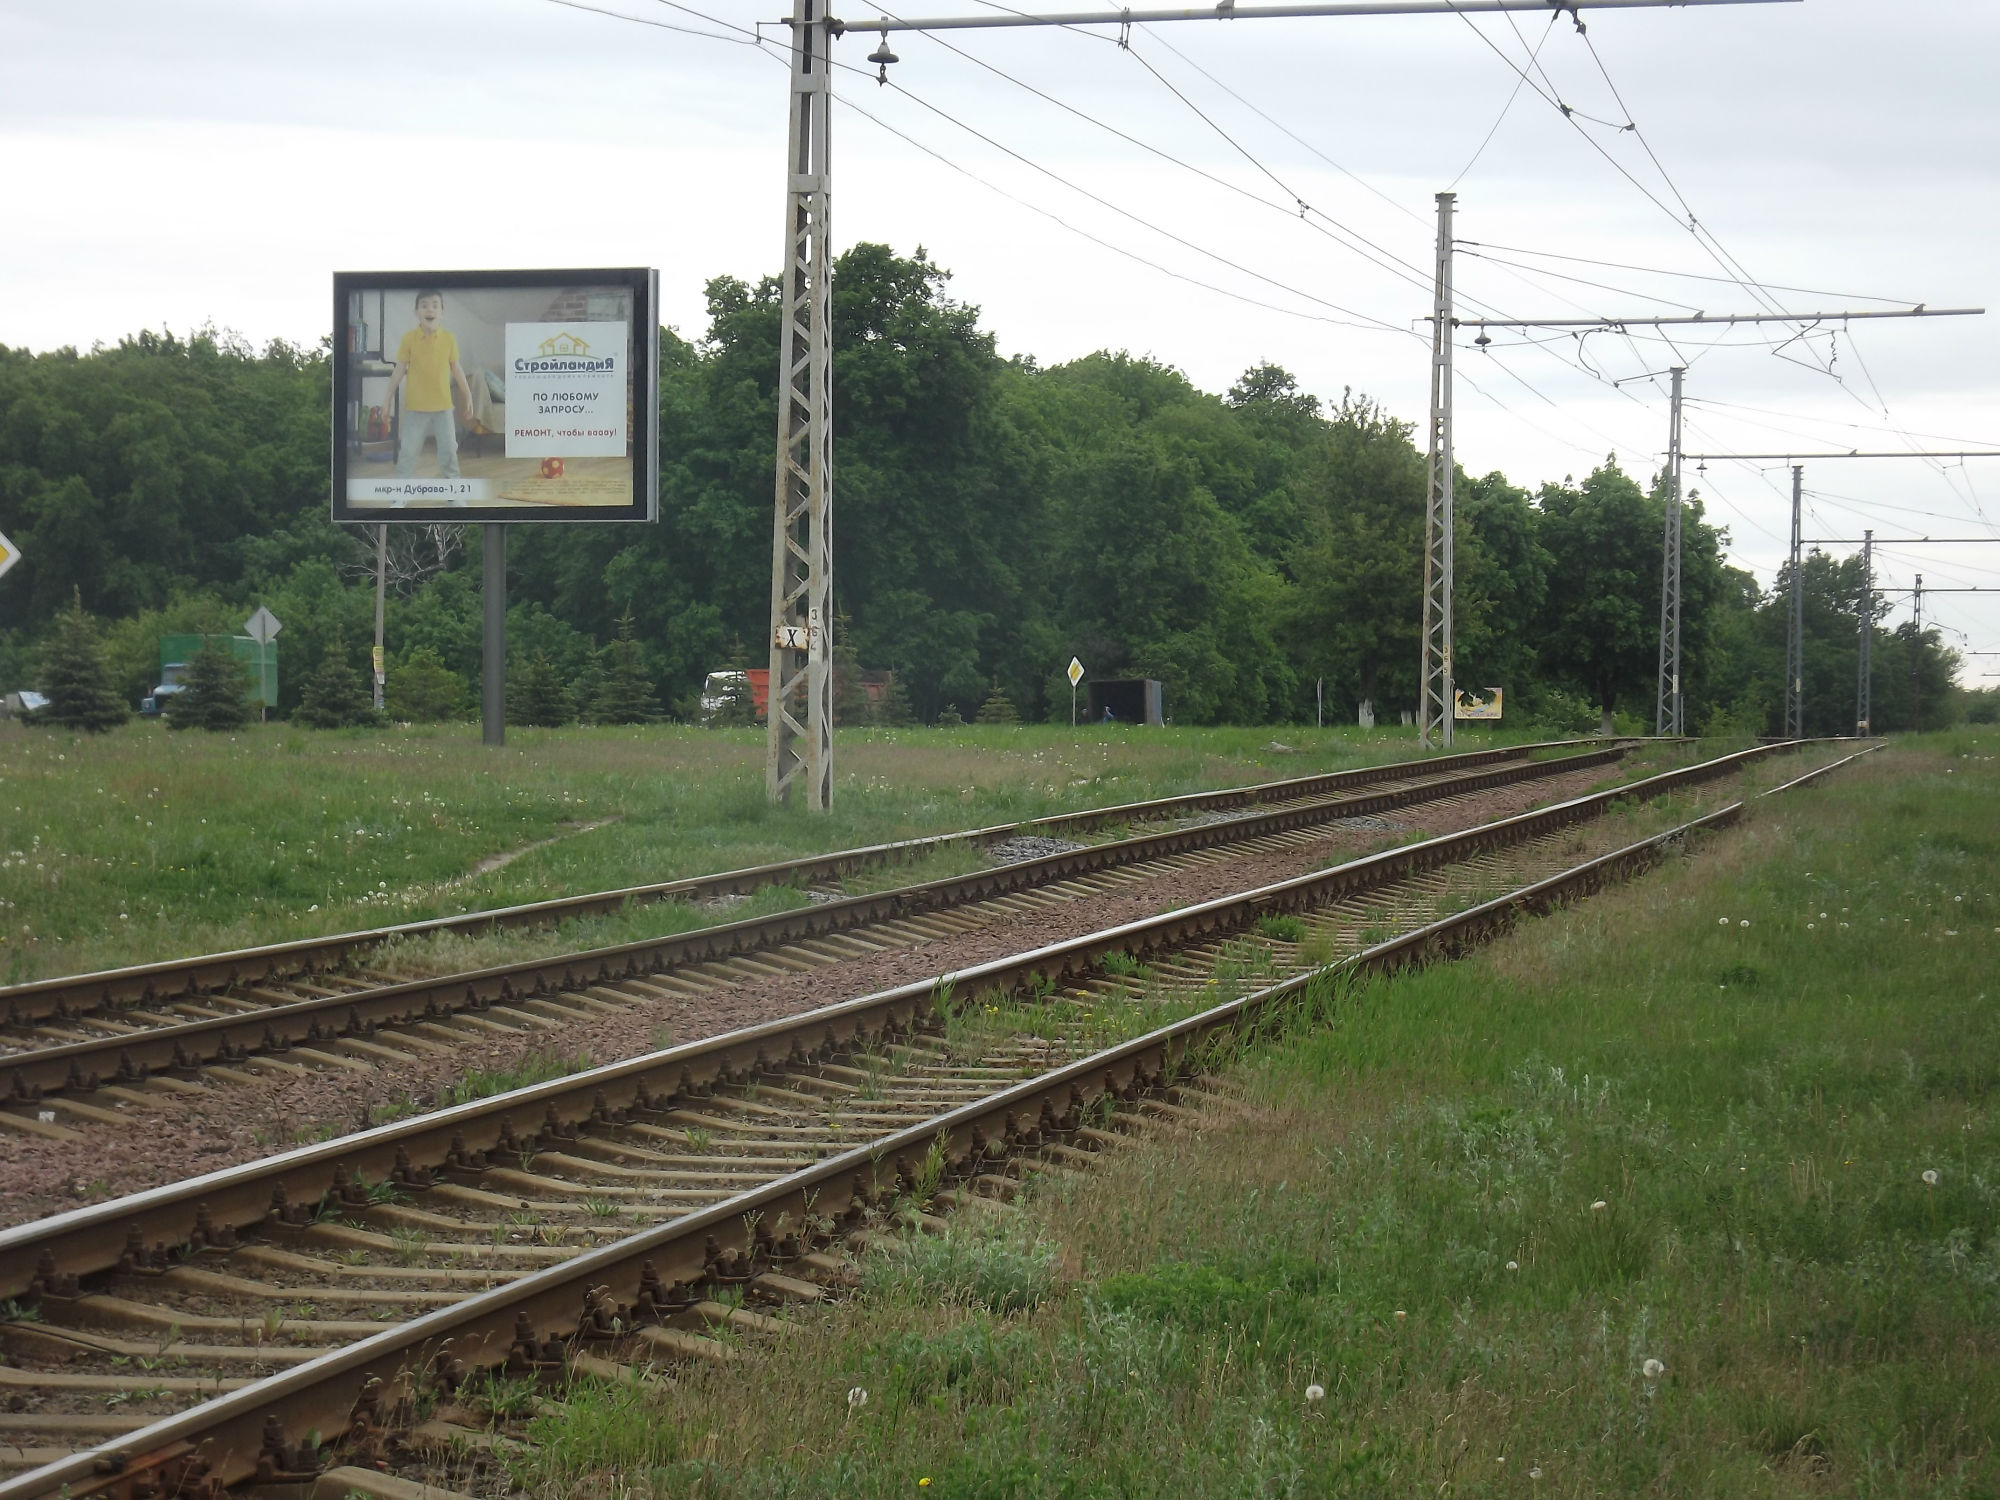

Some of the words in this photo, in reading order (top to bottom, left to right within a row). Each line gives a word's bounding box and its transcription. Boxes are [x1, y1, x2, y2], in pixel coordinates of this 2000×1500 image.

[532, 393, 548, 402] ПО
[551, 392, 599, 402] ЛЮБОМУ
[538, 405, 594, 414] ЗАПРОСУ...
[514, 428, 554, 438] РЕМОНТ,
[557, 428, 585, 437] чтобы
[374, 485, 402, 494] мкр-н
